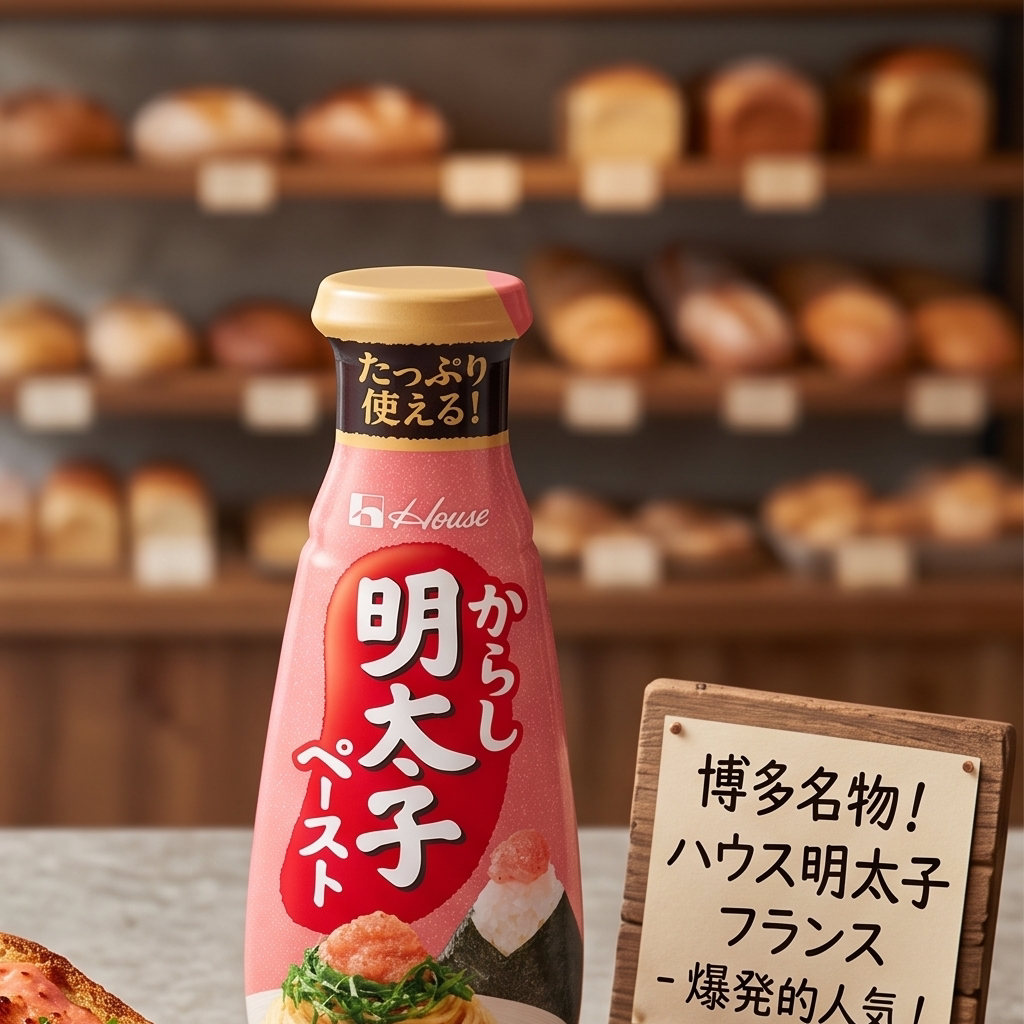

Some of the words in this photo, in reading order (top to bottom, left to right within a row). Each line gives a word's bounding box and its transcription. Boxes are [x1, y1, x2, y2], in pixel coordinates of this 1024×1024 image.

[357, 351, 487, 387] たっぷり
[361, 388, 480, 427] 使える!
[387, 497, 490, 530] House
[467, 584, 523, 752] からし
[356, 567, 478, 889] 明太子
[296, 738, 354, 908] ペースト
[697, 753, 926, 833] 博多名物!
[666, 832, 950, 910] ハウス明太子
[720, 906, 884, 967] フランス
